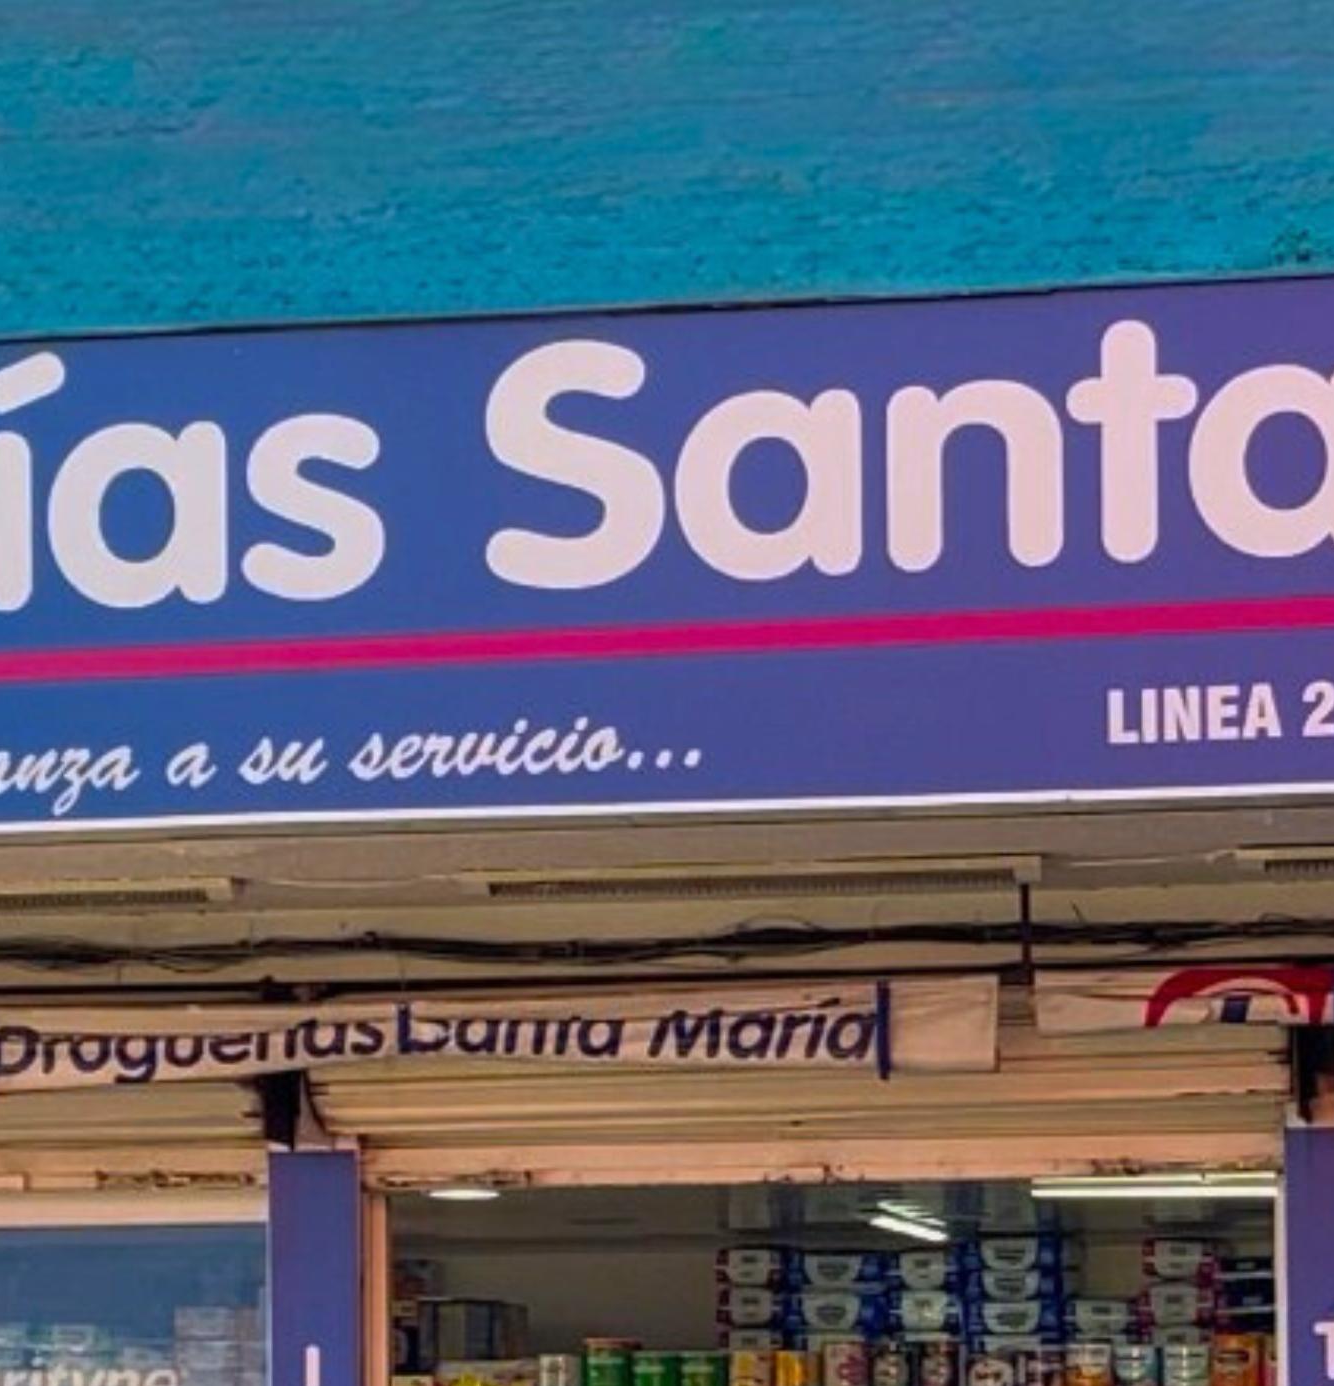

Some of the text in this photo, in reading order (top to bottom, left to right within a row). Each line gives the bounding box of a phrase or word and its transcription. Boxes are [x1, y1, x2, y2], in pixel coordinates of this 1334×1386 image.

[1108, 684, 1281, 744] LINEA
[167, 744, 217, 784] a
[237, 739, 327, 781] su
